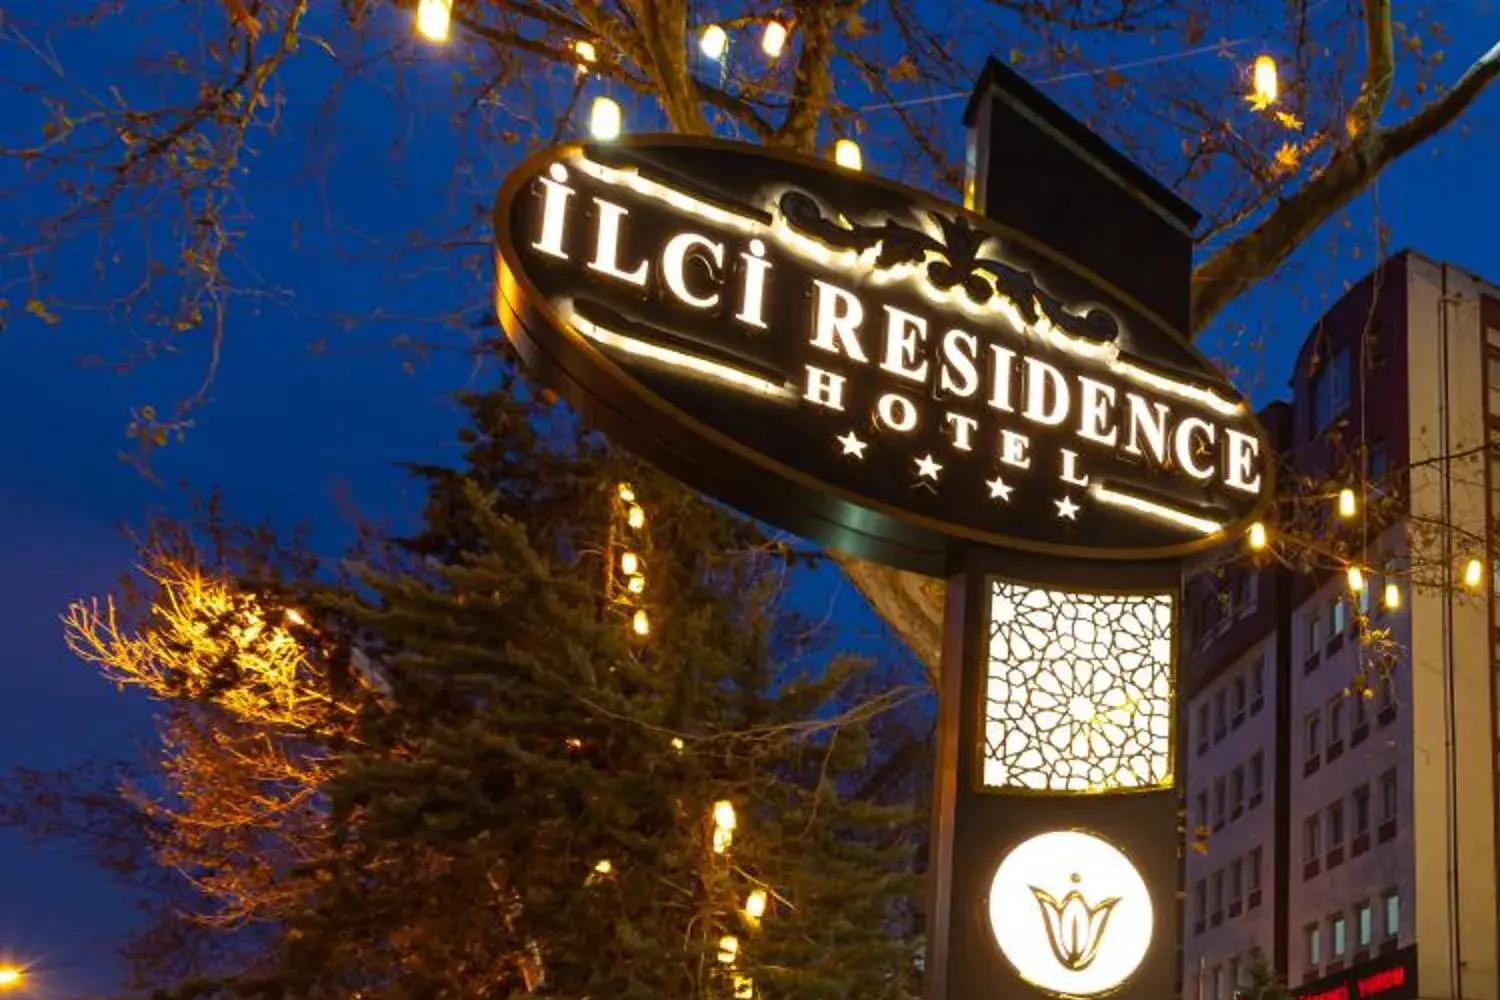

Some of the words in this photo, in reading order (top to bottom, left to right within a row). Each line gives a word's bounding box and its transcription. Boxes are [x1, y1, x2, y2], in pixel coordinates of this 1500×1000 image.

[531, 162, 773, 329] İLCİ
[810, 279, 1261, 494] RESIDENCE
[803, 364, 1090, 487] HOTEL
